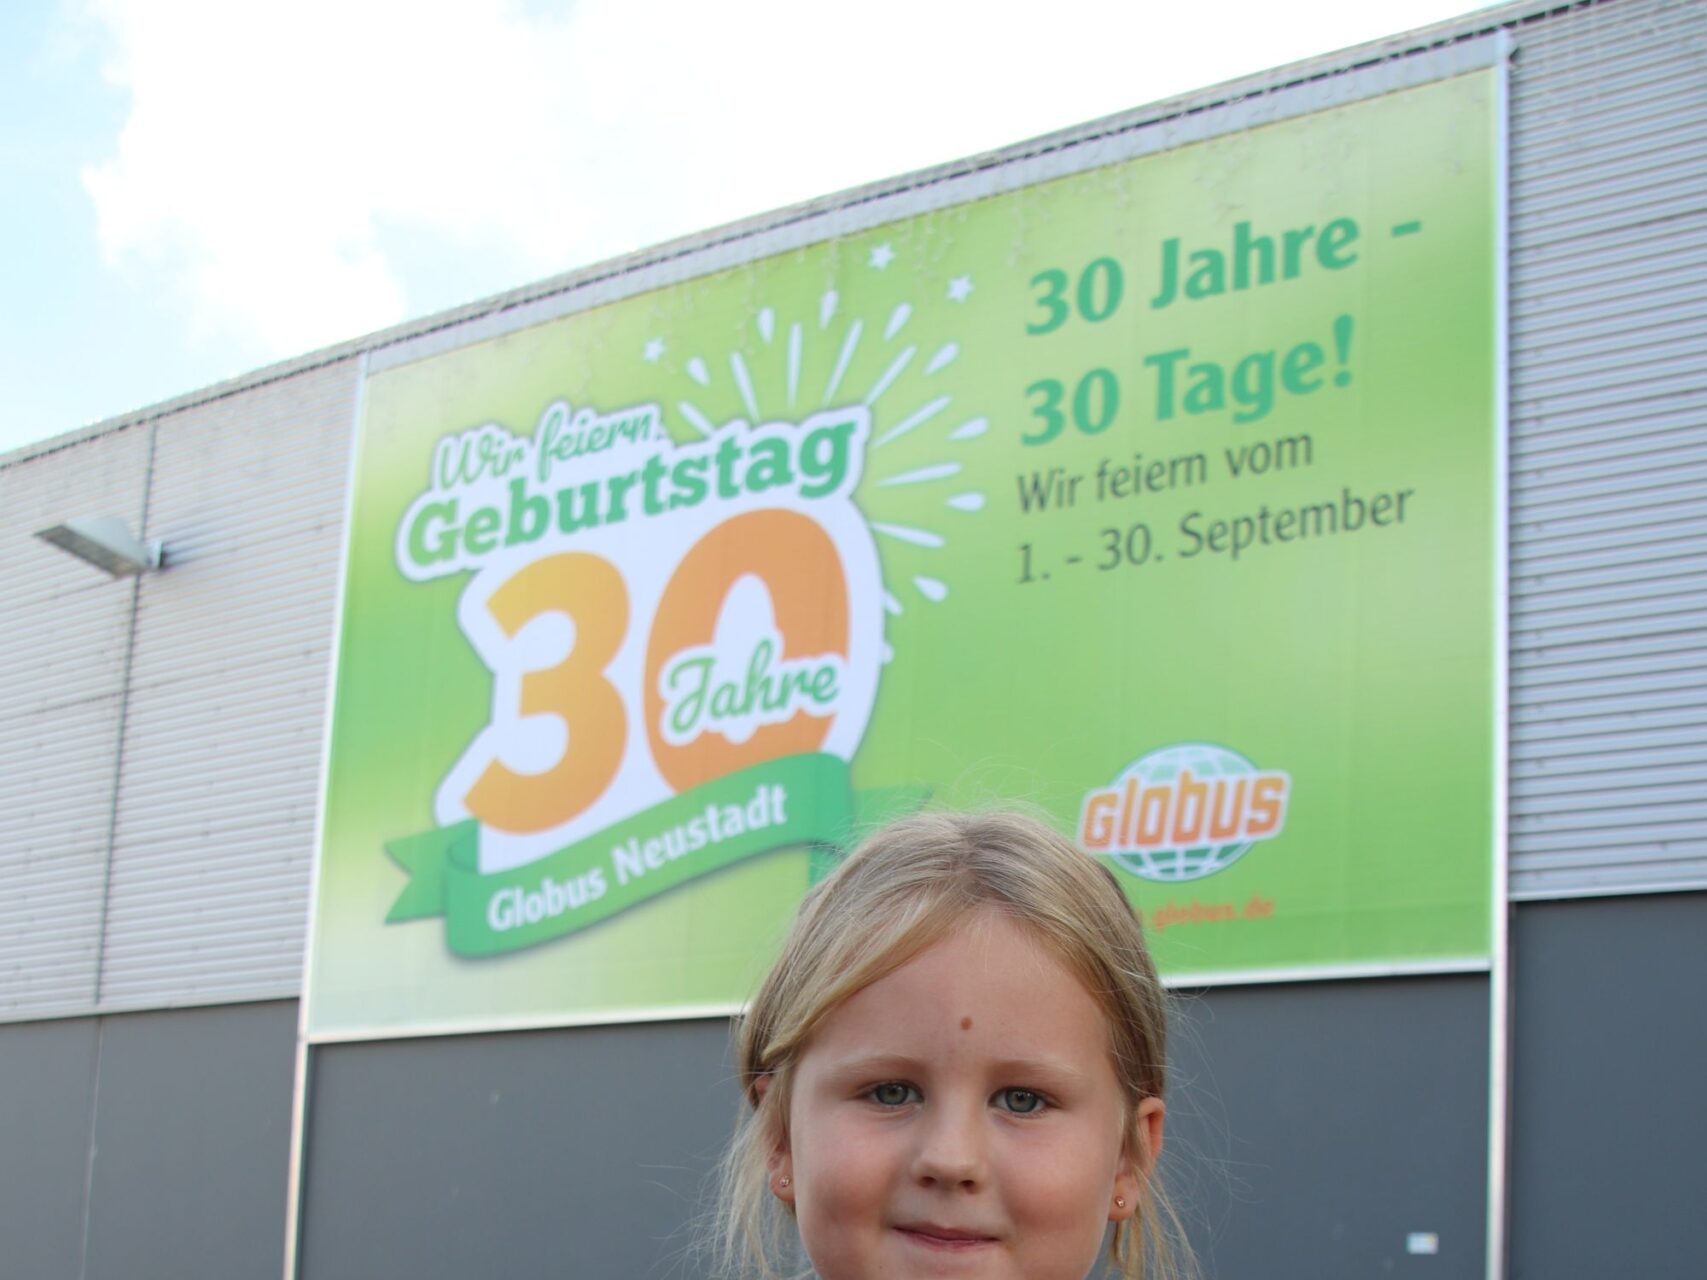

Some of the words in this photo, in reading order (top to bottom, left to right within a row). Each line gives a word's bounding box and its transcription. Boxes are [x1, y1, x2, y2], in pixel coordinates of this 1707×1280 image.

[1025, 256, 1125, 335] 30
[1151, 217, 1360, 310] Jahre
[1391, 219, 1423, 238] -
[1020, 367, 1121, 447] 30
[1142, 313, 1355, 425] Tage!
[407, 420, 857, 567] Geburtstag
[440, 432, 524, 489] Wir
[536, 404, 653, 482] feiern
[1016, 466, 1082, 514] Wir
[1096, 451, 1208, 503] feiern
[1224, 433, 1313, 479] vom
[1016, 542, 1051, 584] 1.
[1097, 523, 1164, 572] 30.
[1178, 486, 1415, 561] September
[462, 507, 851, 836] 30
[667, 639, 839, 734] Jahre
[487, 867, 607, 931] Globus
[611, 784, 787, 885] Neustadt
